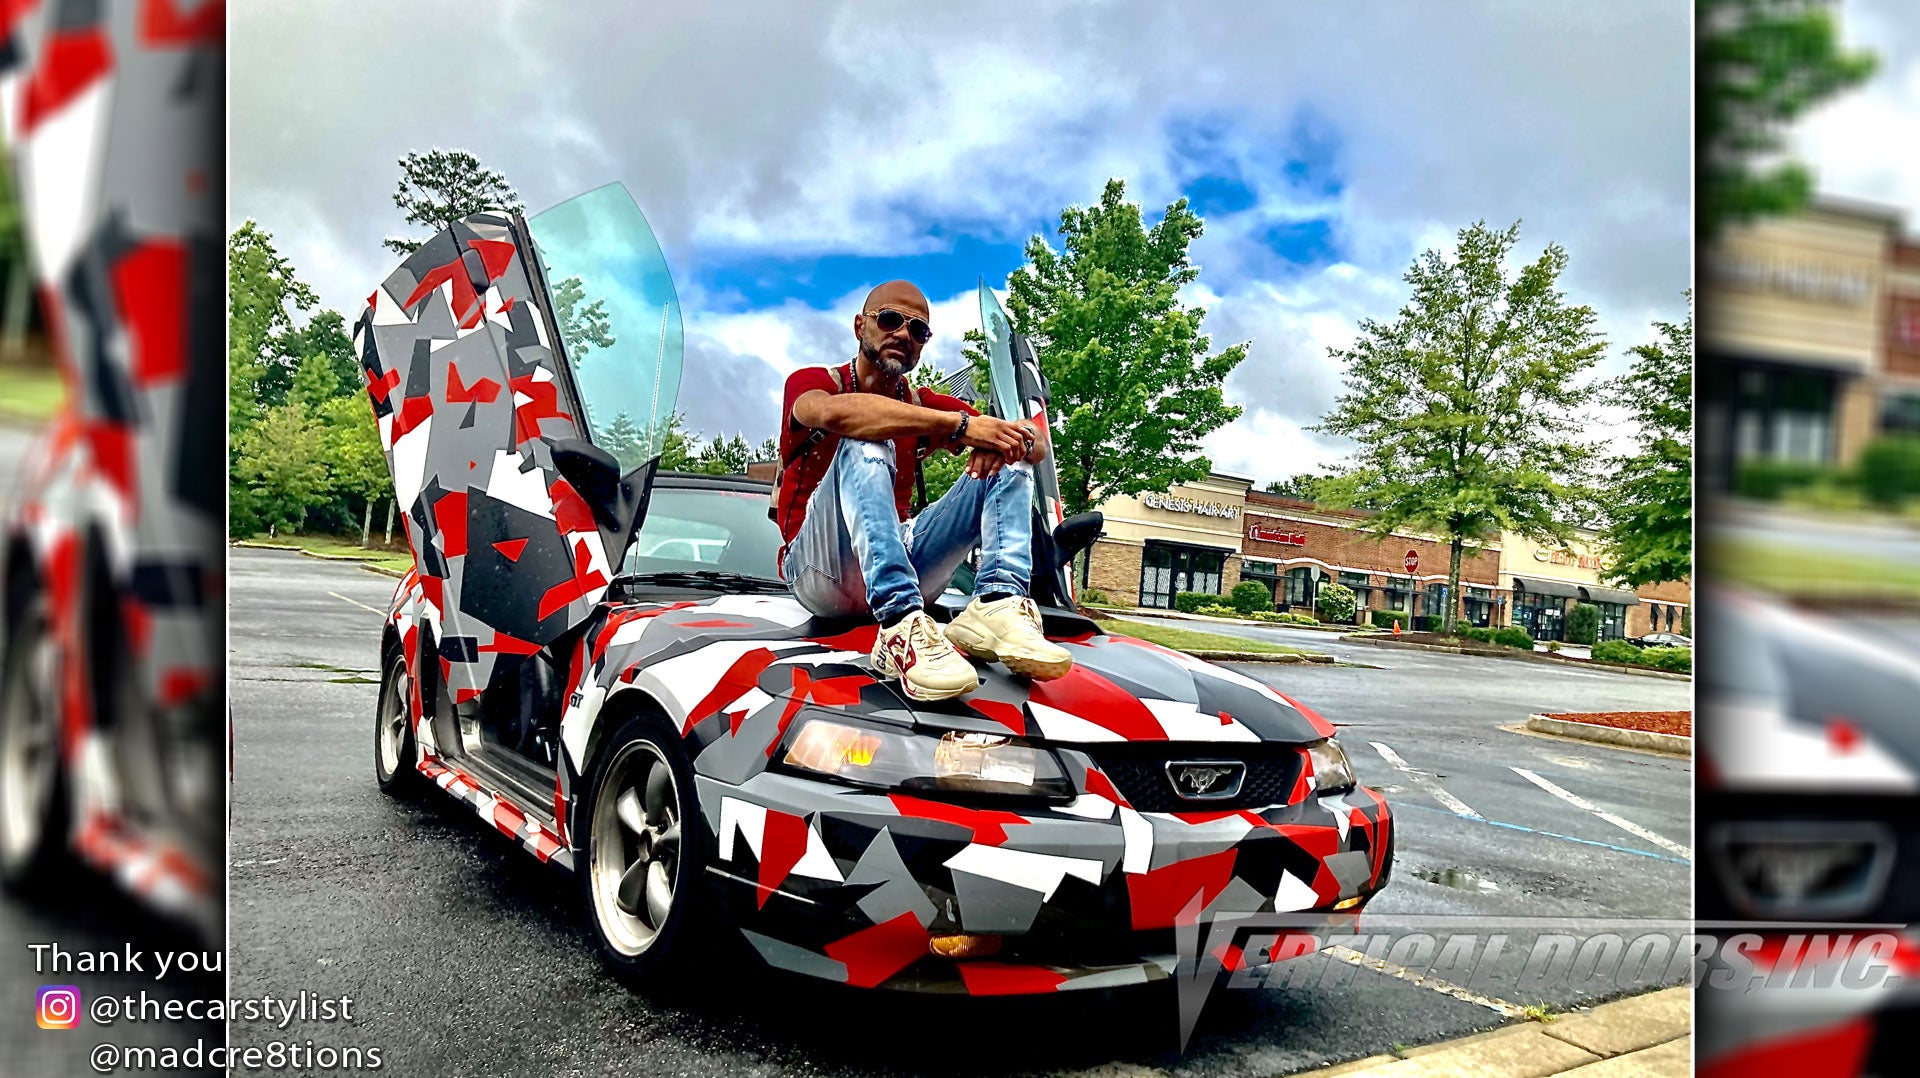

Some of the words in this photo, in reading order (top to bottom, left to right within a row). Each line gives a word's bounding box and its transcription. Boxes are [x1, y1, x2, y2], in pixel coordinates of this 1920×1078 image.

[1145, 492, 1191, 513] GENESIS
[1192, 502, 1218, 517] HAIR
[1219, 506, 1240, 520] ART
[1405, 556, 1418, 567] STOP
[570, 692, 584, 709] GT
